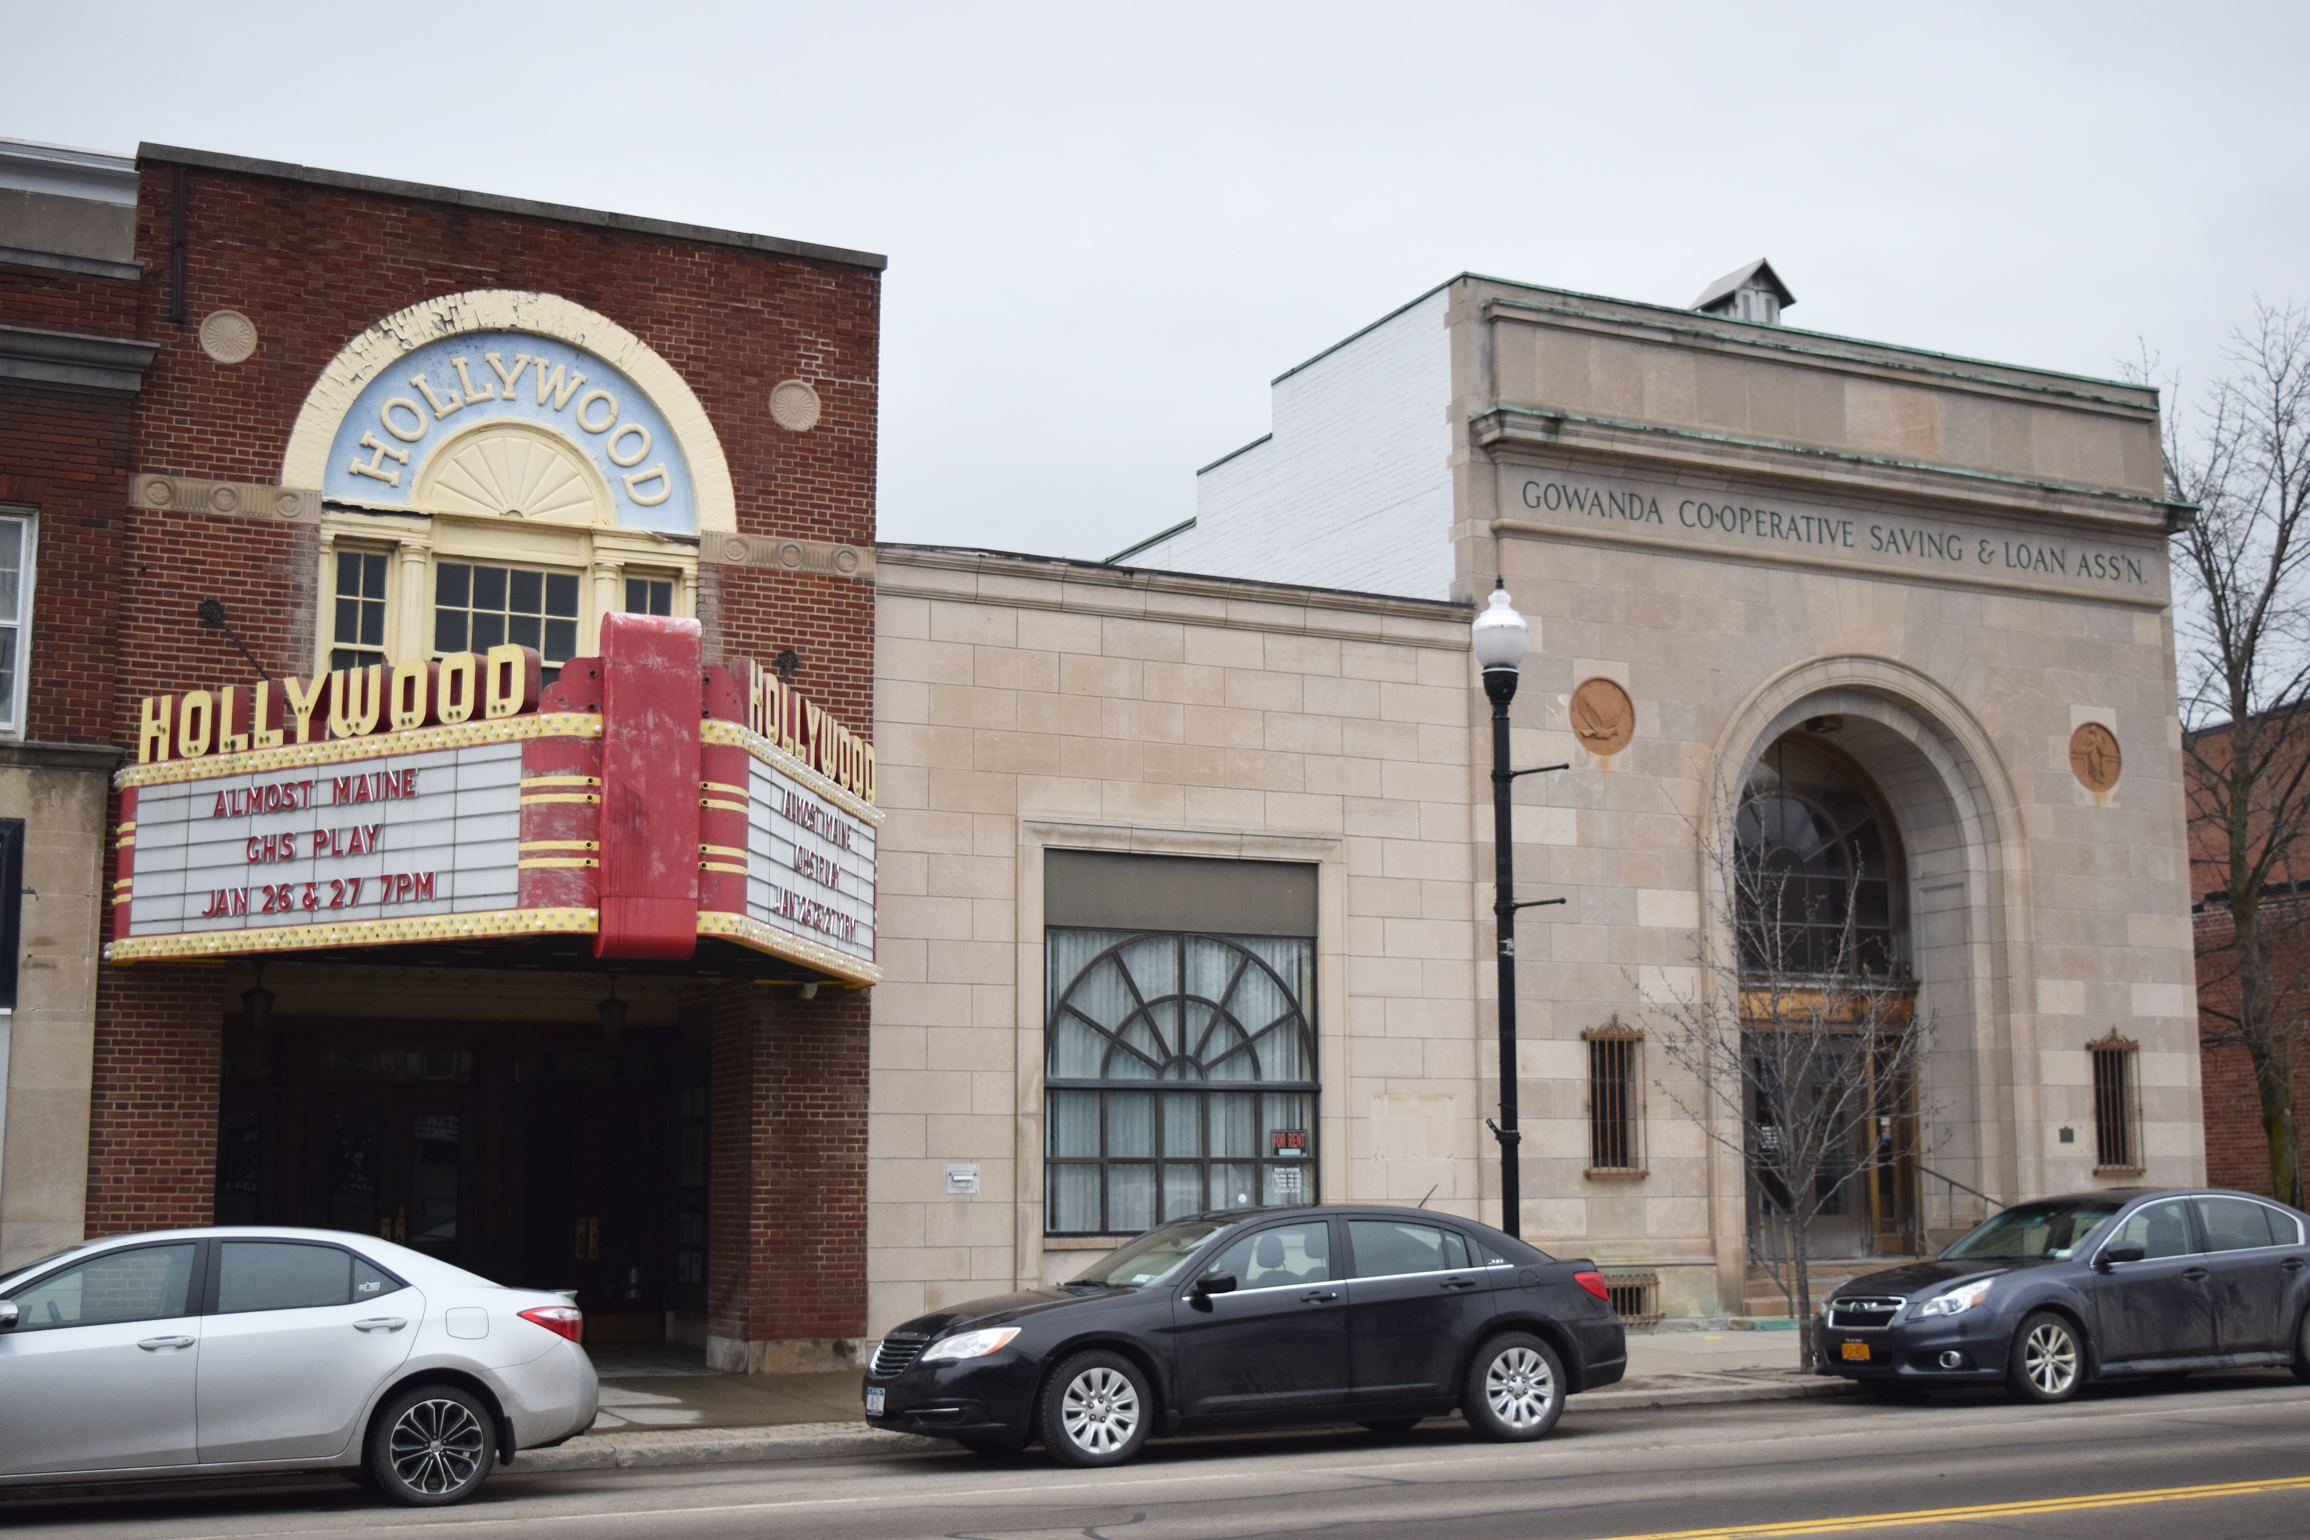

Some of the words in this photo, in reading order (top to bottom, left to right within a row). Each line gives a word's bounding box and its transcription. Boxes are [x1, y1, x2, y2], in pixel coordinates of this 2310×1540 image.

[349, 353, 671, 506] HOLLYWOOD
[1522, 480, 1664, 525] GOWANDA
[1869, 525, 1963, 561] SAVING
[1977, 539, 1995, 565] &
[2004, 542, 2066, 574] LOAN
[138, 643, 540, 764] HOLLYWOOD
[750, 658, 876, 802] HOLLYWOOD
[213, 779, 316, 818] ALMOST
[332, 768, 418, 806] MAINE
[783, 788, 820, 832] ALMOST
[824, 812, 851, 849] MAINE
[246, 831, 296, 865] GHS
[313, 824, 382, 859] PLAY
[202, 886, 251, 918] JAN
[262, 882, 294, 914] 26
[302, 881, 319, 911] &
[330, 877, 363, 908] 27
[381, 871, 436, 904] 7PM
